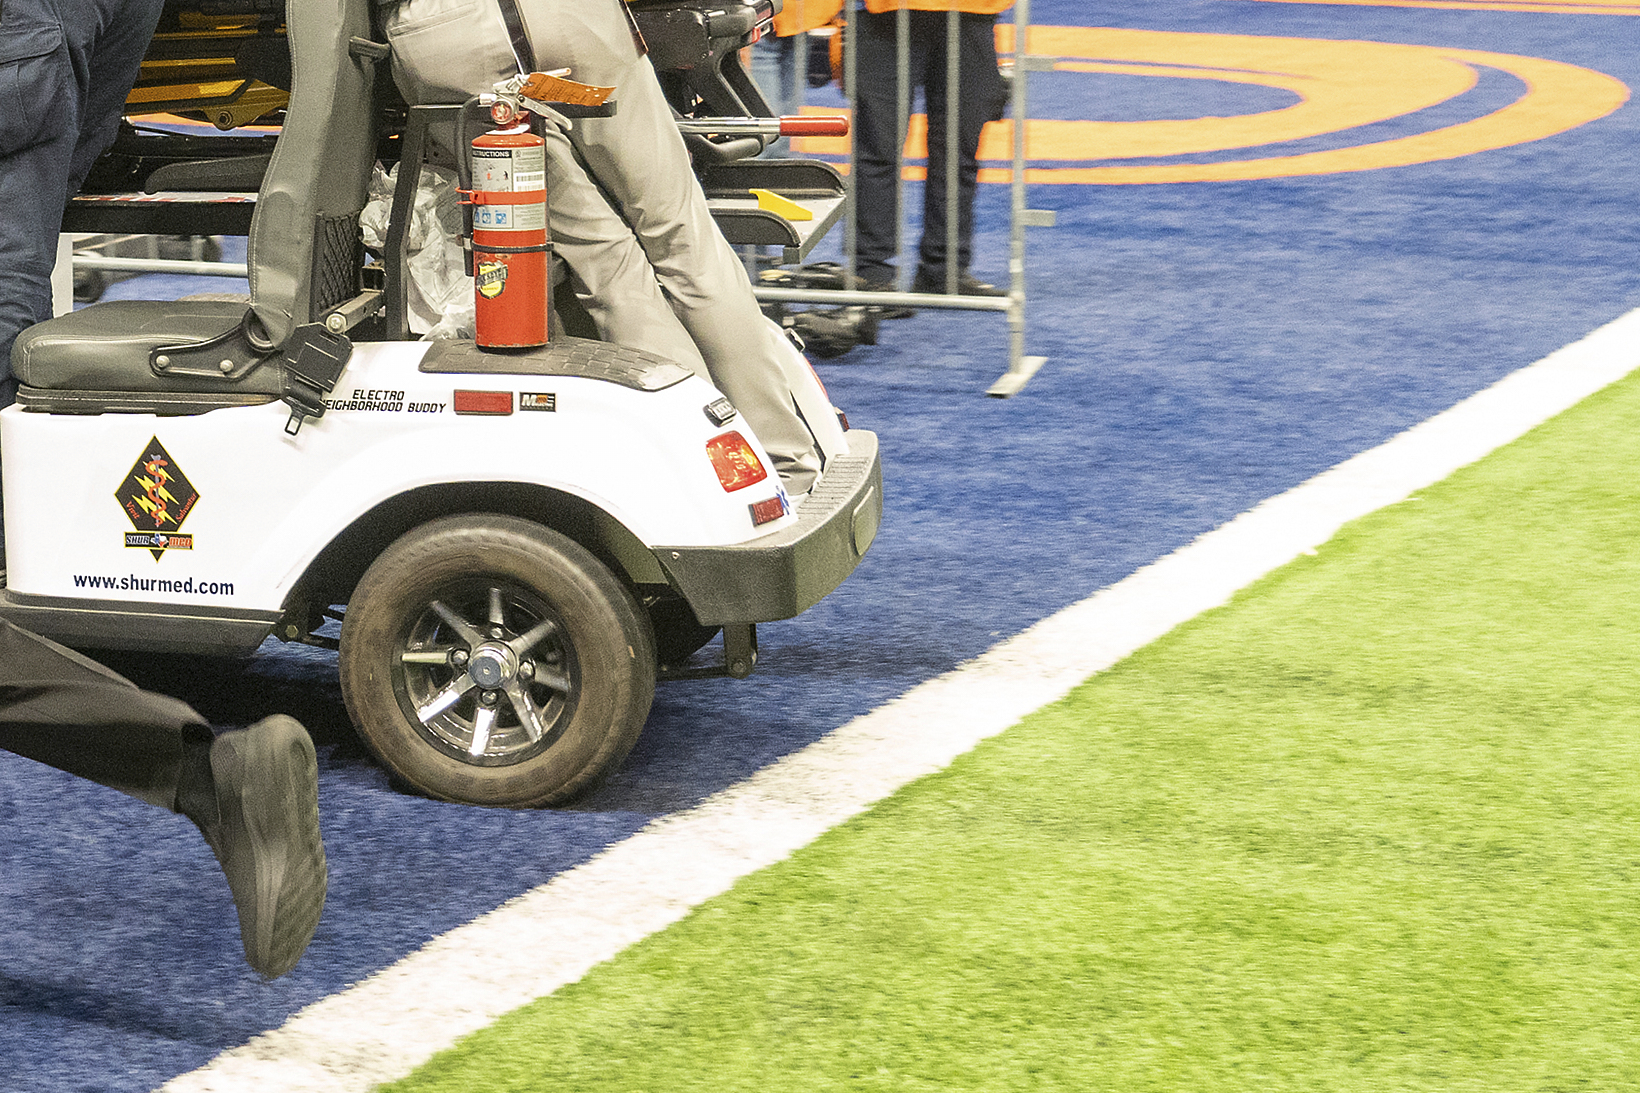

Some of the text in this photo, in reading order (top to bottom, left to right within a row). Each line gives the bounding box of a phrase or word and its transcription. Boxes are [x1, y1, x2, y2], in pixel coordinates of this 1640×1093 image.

[352, 389, 405, 401] ELECTRO
[407, 402, 447, 414] BUDDY
[73, 574, 234, 596] www.shurmed.com
